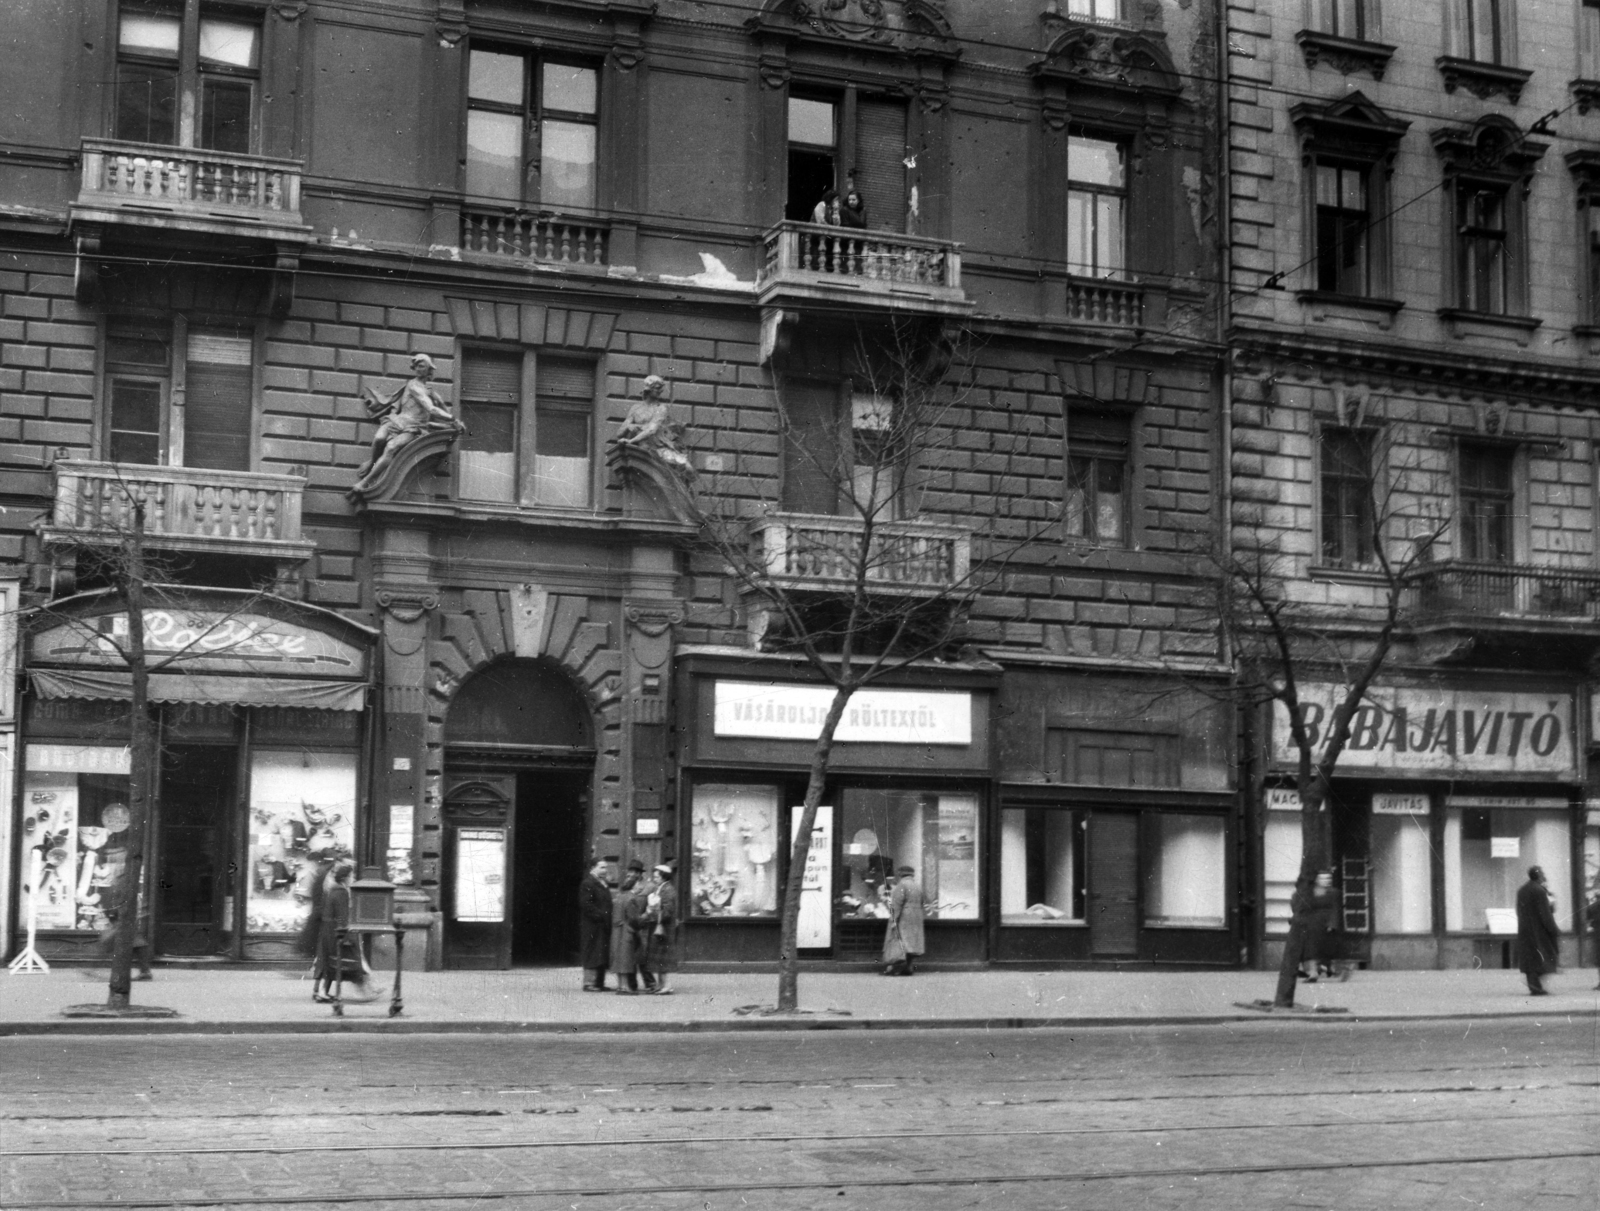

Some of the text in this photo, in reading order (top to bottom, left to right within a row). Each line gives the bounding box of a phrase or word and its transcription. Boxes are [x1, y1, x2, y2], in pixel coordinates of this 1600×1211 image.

[734, 698, 936, 728] VÁSÁROLJO RÖLTEXTŐL
[1287, 700, 1562, 757] BABAJAVITÓ
